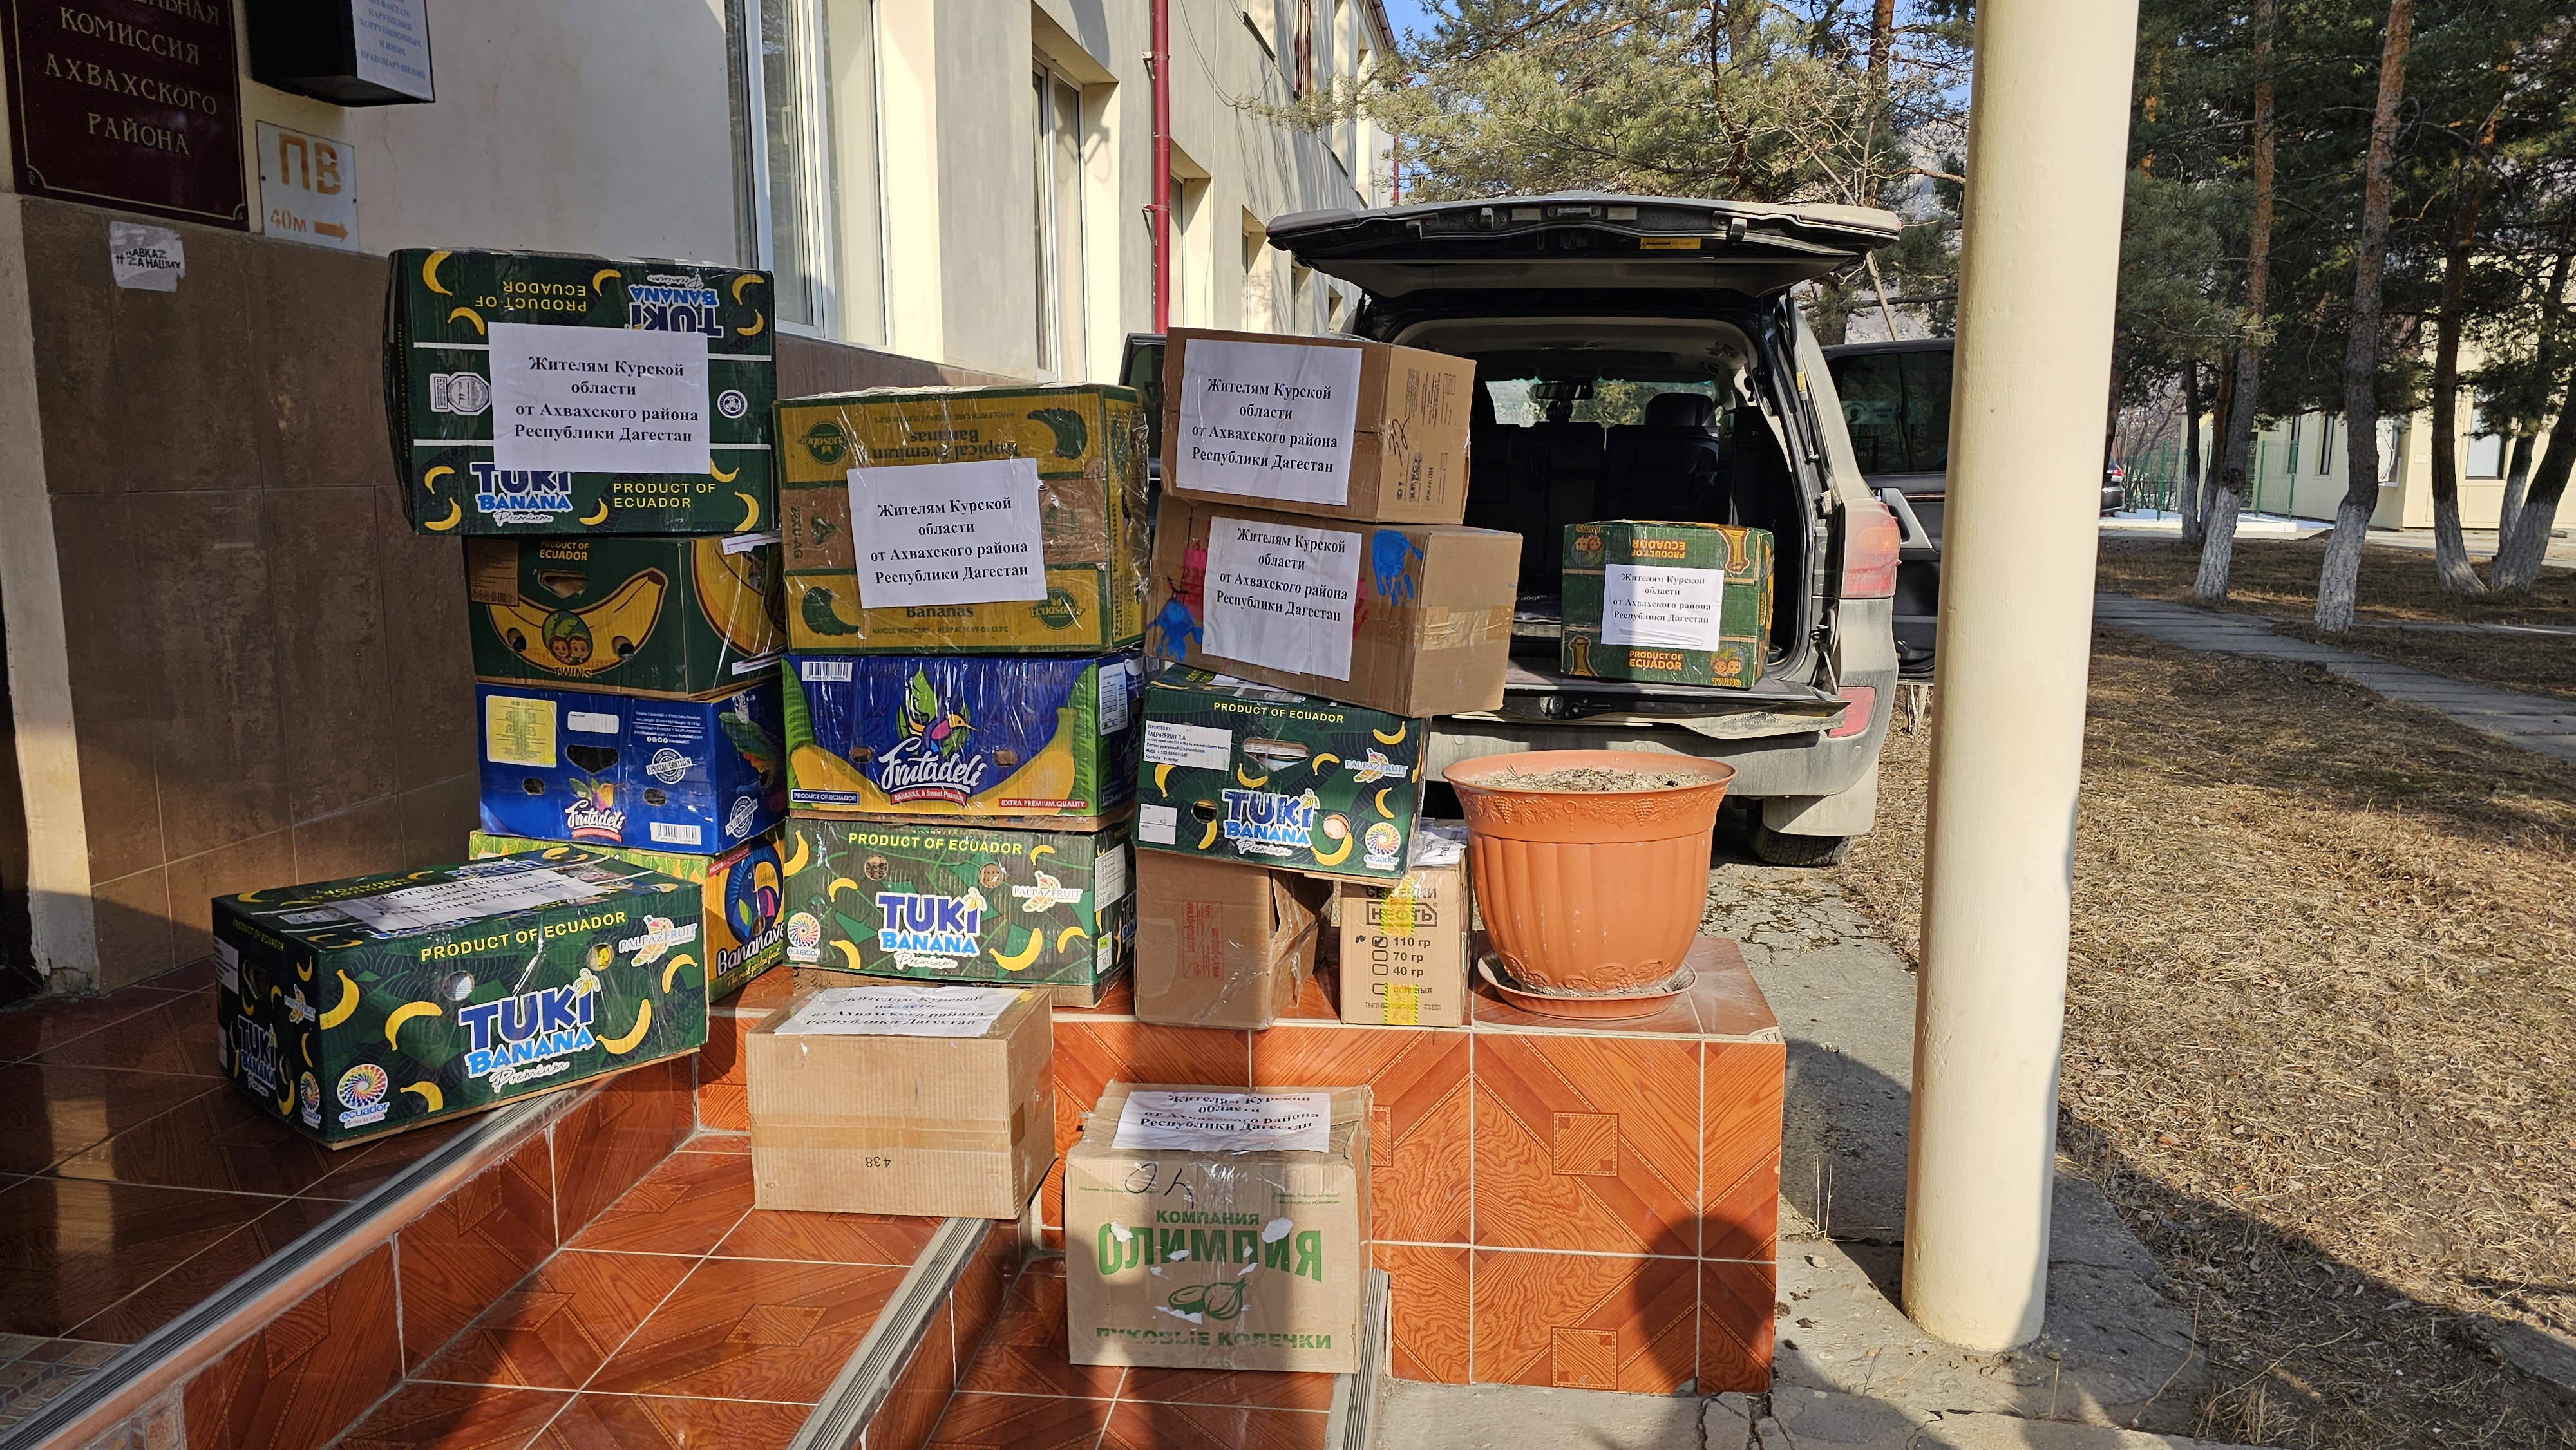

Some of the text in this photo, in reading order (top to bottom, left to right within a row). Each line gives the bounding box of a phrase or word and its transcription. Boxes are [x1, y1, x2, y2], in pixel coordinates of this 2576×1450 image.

[60, 6, 200, 65] КОМИССИЯ
[44, 53, 217, 115] АХВАХСКОГО
[87, 112, 189, 155] РАЙОНА
[279, 133, 343, 195] ПВ
[503, 281, 586, 296] ECUADOR
[647, 275, 704, 288] Premium
[475, 296, 587, 312] PRODUCT OF
[630, 286, 717, 306] BANANA
[630, 304, 723, 337] TUKI
[529, 357, 683, 377] Жителям Курской
[571, 381, 636, 395] области
[1208, 378, 1331, 400] Жителям Курской
[516, 404, 699, 423] от Ахвахского района
[1240, 404, 1293, 420] области
[515, 425, 692, 443] Республики Дагестан
[910, 429, 978, 442] Bananas
[1192, 425, 1338, 449] от Ахвахского района
[1192, 448, 1333, 474] Республики Дагестан
[471, 464, 570, 493] TUKI
[614, 483, 716, 494] PRODUCT OF
[478, 494, 572, 510] BANANA
[614, 497, 691, 508] ECUADOR
[878, 497, 1012, 517] Жителям Курской
[495, 510, 552, 523] Premium
[918, 522, 975, 536] области
[540, 540, 576, 549] PRODUCT
[1238, 528, 1345, 554] Жителям Курской
[1632, 540, 1686, 550] ECUADOR
[540, 549, 588, 561] ECUADOR
[871, 551, 886, 562] от
[890, 546, 972, 561] Ахвахского
[976, 541, 1028, 558] района
[1643, 549, 1685, 558] PRODUCT
[1258, 554, 1305, 570] области
[875, 563, 1028, 587] Республики Дагестан
[1622, 573, 1705, 585] Жителям Курской
[1220, 573, 1347, 601] от Ахвахского района
[1645, 587, 1680, 596] области
[1217, 590, 1340, 622] Республики Дагестан
[1625, 599, 1676, 608] Ахвахского
[906, 606, 974, 619] Bananas
[1614, 611, 1709, 623] Республики Дагестан
[1629, 650, 1683, 661] PRODUCT OF
[554, 667, 592, 678] TWINS
[1629, 659, 1682, 671] ECUADOR
[1712, 677, 1741, 687] TWINS
[1214, 702, 1344, 724] PRODUCT OF ECUADOR
[1147, 731, 1177, 740] PALPAZFRUIT
[647, 757, 691, 774] SPECIAL EDITION
[877, 737, 987, 789] Frutadeli
[1346, 760, 1407, 773] PALPAZFRUIT
[793, 793, 857, 803] PRODUCT ECUADOR
[1022, 800, 1055, 808] PREMIUM
[1056, 800, 1086, 809] QUALITY
[565, 800, 626, 829] Frutadeli
[1224, 789, 1316, 828] TUKI
[1227, 822, 1309, 846] BANANA
[849, 833, 1023, 855] PRODUCT OF ECUADOR
[1238, 840, 1292, 855] Premium
[1365, 854, 1398, 864] ecuador
[1014, 887, 1081, 898] PALPAZFRUIT
[878, 894, 981, 934] TUKI
[421, 911, 627, 962] PRODUCT OF ECUADOR
[620, 925, 696, 949] PALPAZFRUIT
[882, 931, 978, 955] BANANA
[1393, 937, 1431, 948] 110 гр
[896, 951, 956, 968] Premium
[1393, 952, 1424, 963] 70 гр
[1393, 967, 1424, 977] 40 гр
[460, 984, 594, 1050] TUKI
[238, 1015, 276, 1070] TUKI
[469, 1028, 594, 1075] BANANA
[490, 1062, 569, 1089] Premium
[341, 1102, 388, 1120] ecuador
[1140, 1118, 1235, 1131] Республики
[864, 1156, 891, 1169] 438
[1156, 1210, 1260, 1226] КОМПАНИЯ
[1097, 1222, 1323, 1283] ОЛИМПИЯ
[1218, 1332, 1331, 1349] КОЛЕЧКИ
